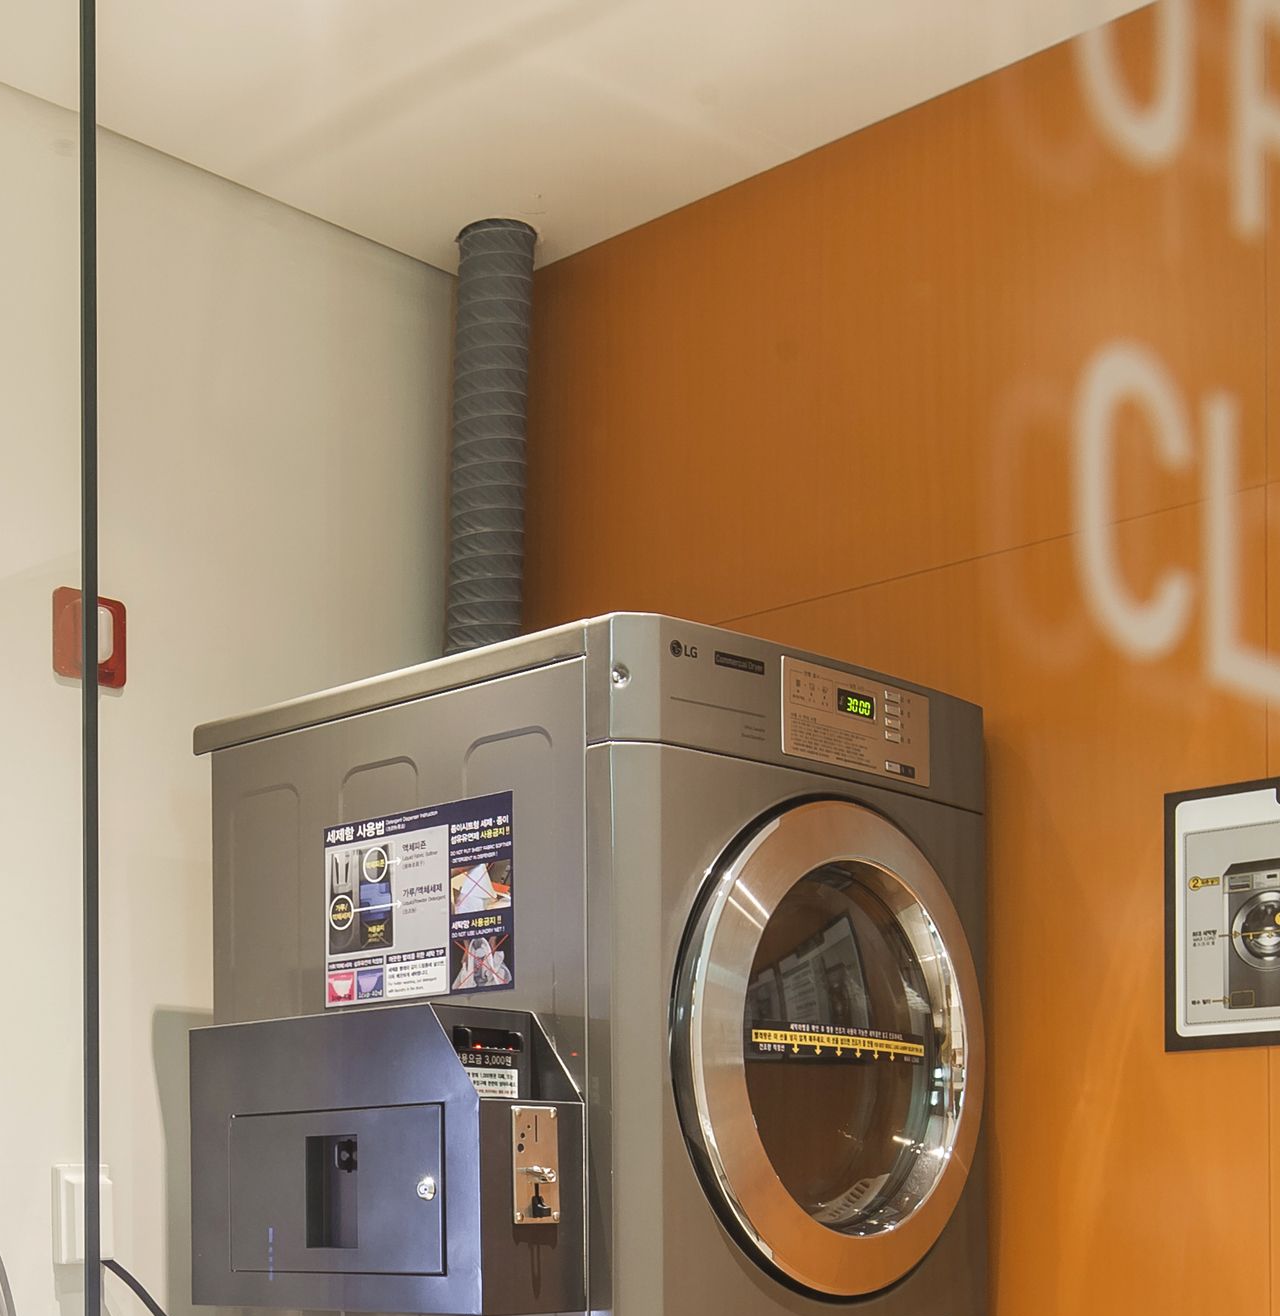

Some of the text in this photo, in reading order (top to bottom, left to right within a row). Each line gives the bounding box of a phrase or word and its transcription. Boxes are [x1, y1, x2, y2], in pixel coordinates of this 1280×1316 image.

[684, 645, 698, 658] LG
[326, 827, 354, 843] 세제함
[356, 820, 385, 838] 사용법
[480, 828, 504, 839] 사용금지
[471, 917, 496, 927] 사용금지
[459, 1053, 512, 1067] 용요금 3,000원
